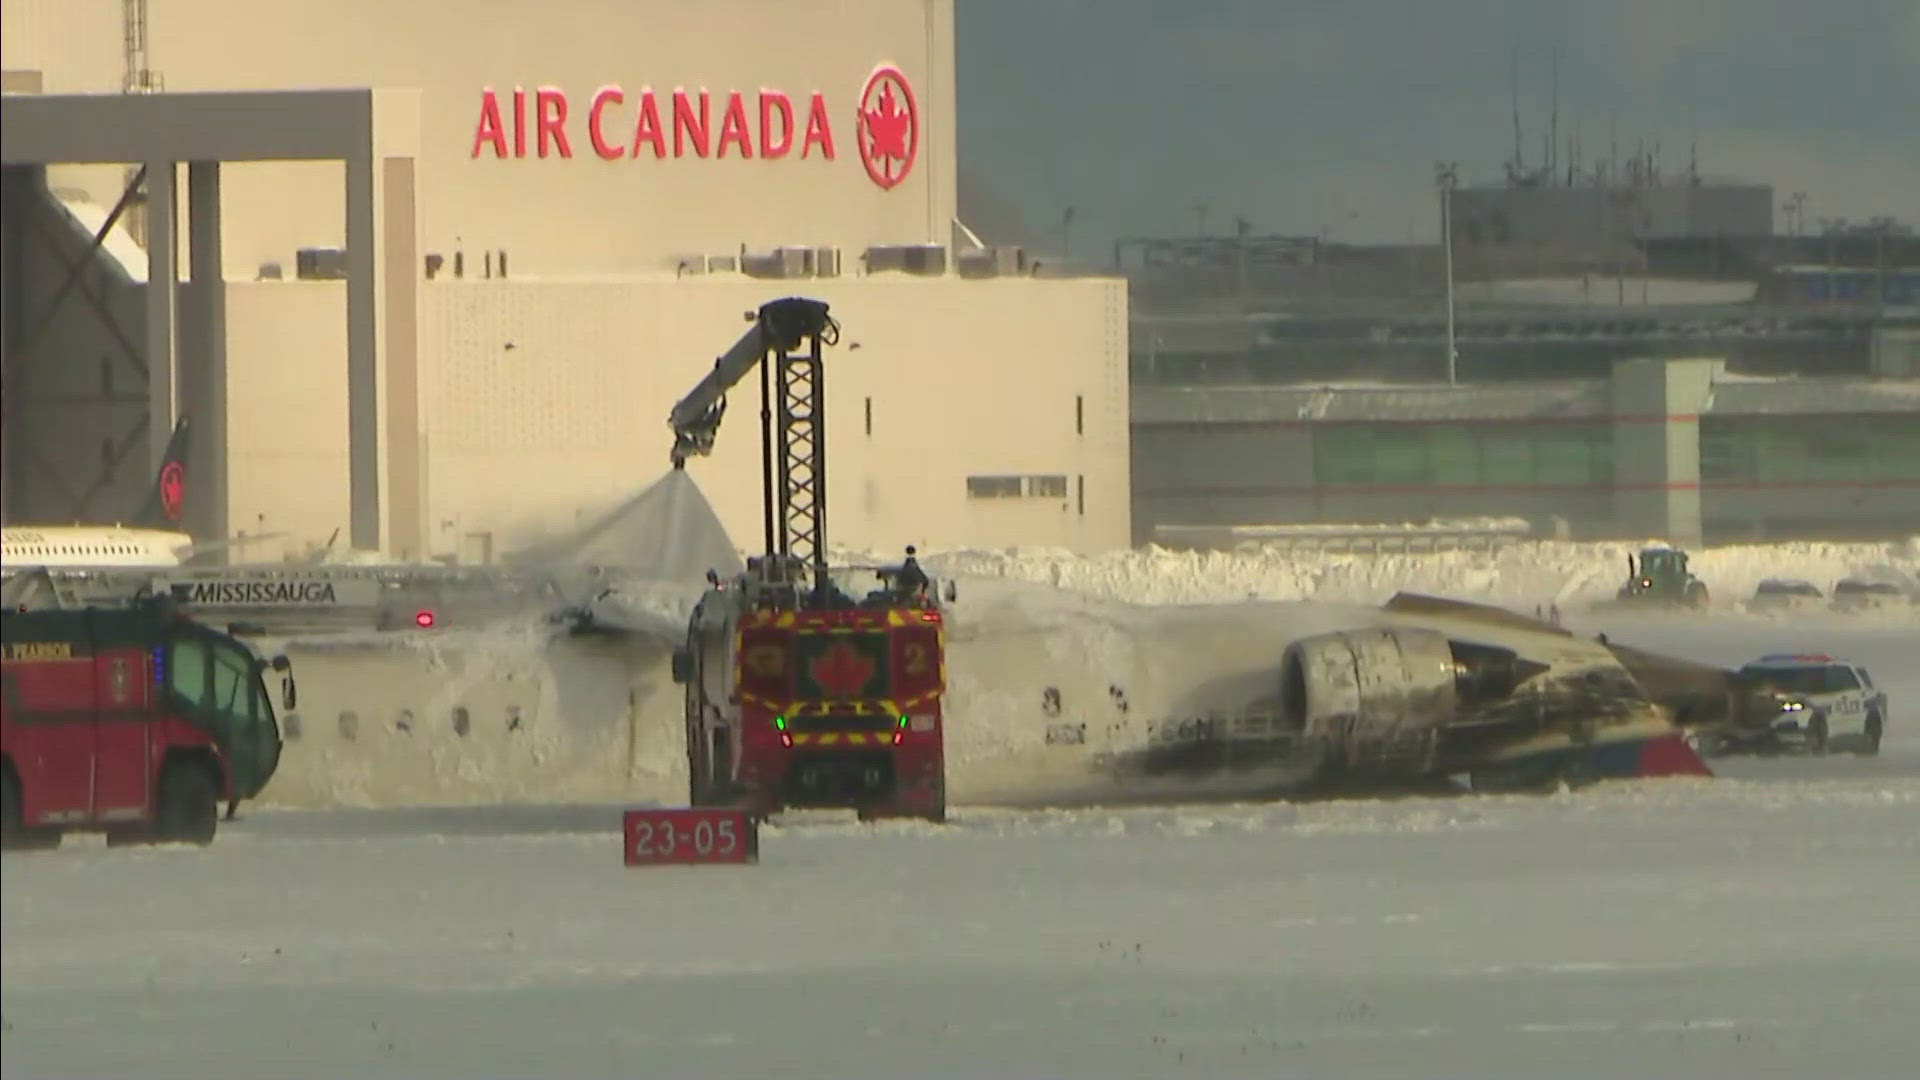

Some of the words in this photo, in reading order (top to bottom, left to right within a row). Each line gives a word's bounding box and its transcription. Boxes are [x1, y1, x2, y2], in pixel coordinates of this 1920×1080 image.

[473, 87, 571, 159] AIR
[589, 86, 836, 160] CANADA
[194, 582, 336, 603] MISSISSAUGA
[635, 820, 737, 856] 23-05
